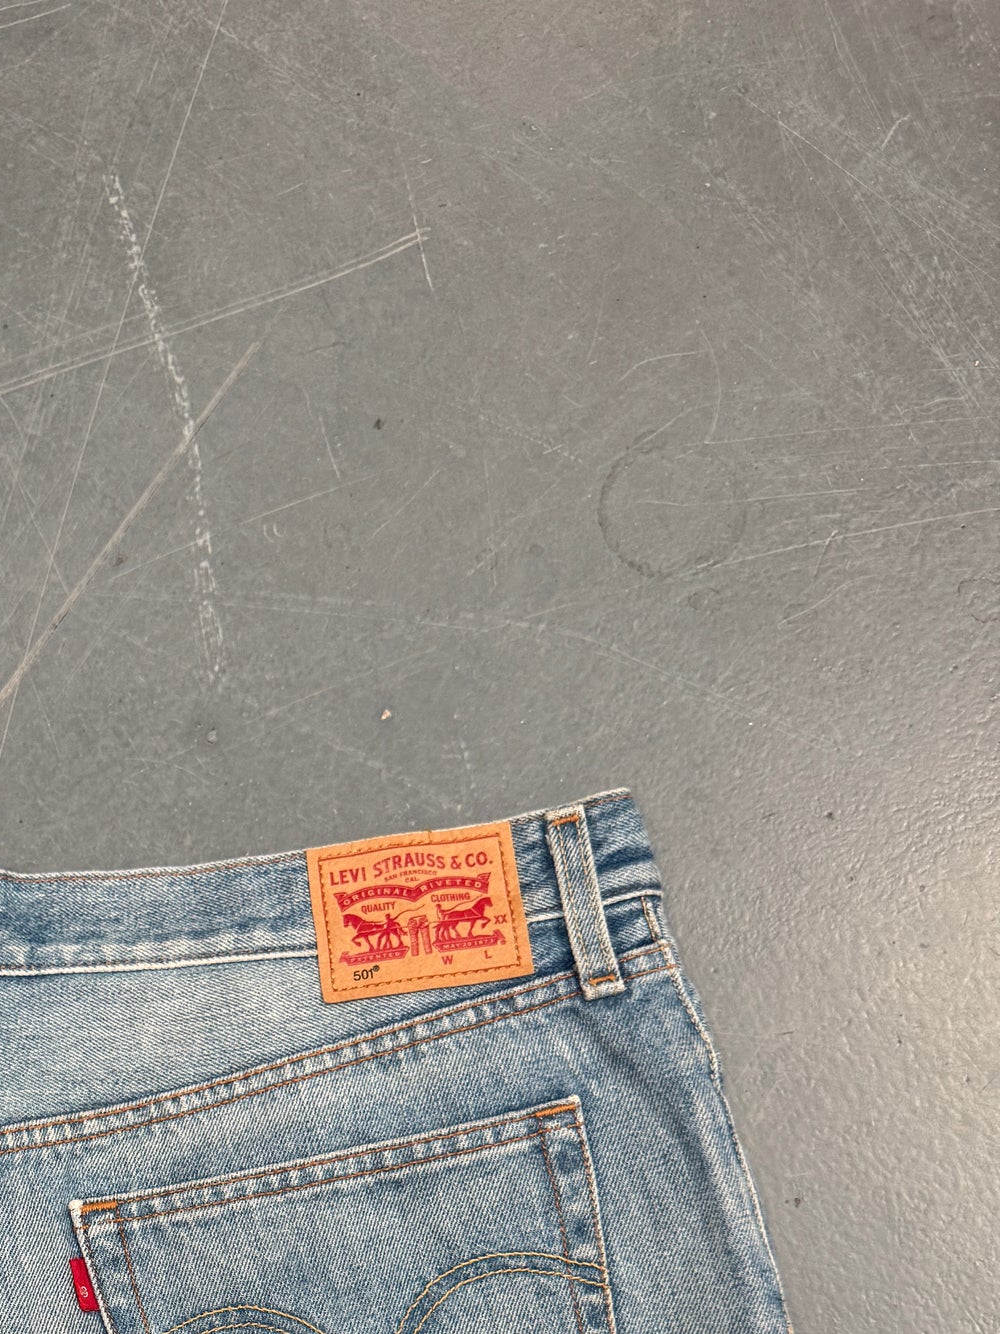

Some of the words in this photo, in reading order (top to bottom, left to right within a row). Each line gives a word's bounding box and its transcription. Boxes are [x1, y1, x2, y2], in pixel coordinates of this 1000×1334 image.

[329, 867, 367, 886] LEVI
[373, 852, 446, 878] STRAUSS
[450, 855, 462, 869] &
[465, 851, 493, 868] CO.
[343, 888, 409, 905] ORIGINAL
[419, 879, 482, 893] RIVETED
[431, 892, 471, 903] CLOTHING
[361, 901, 396, 914] QUALITY
[494, 914, 507, 924] XX
[441, 955, 453, 965] W
[484, 950, 492, 959] L
